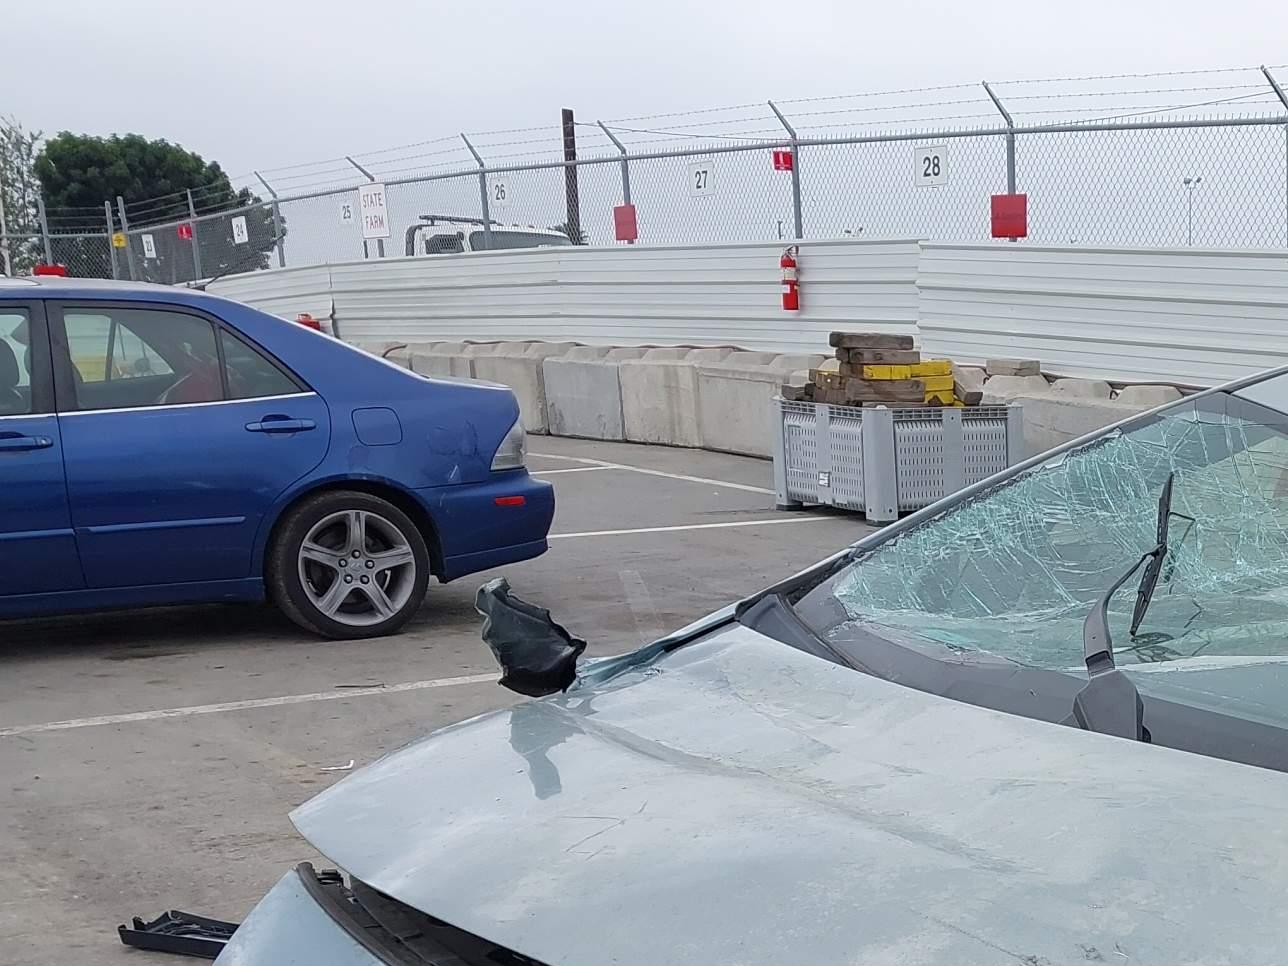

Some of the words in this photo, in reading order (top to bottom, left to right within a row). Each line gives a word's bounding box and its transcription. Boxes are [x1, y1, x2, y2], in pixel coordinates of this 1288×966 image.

[922, 155, 941, 177] 28
[694, 170, 708, 189] 27
[362, 191, 384, 208] STATE
[494, 183, 506, 201] 26
[342, 204, 352, 220] 25
[235, 223, 245, 238] 24
[365, 215, 385, 230] FARM
